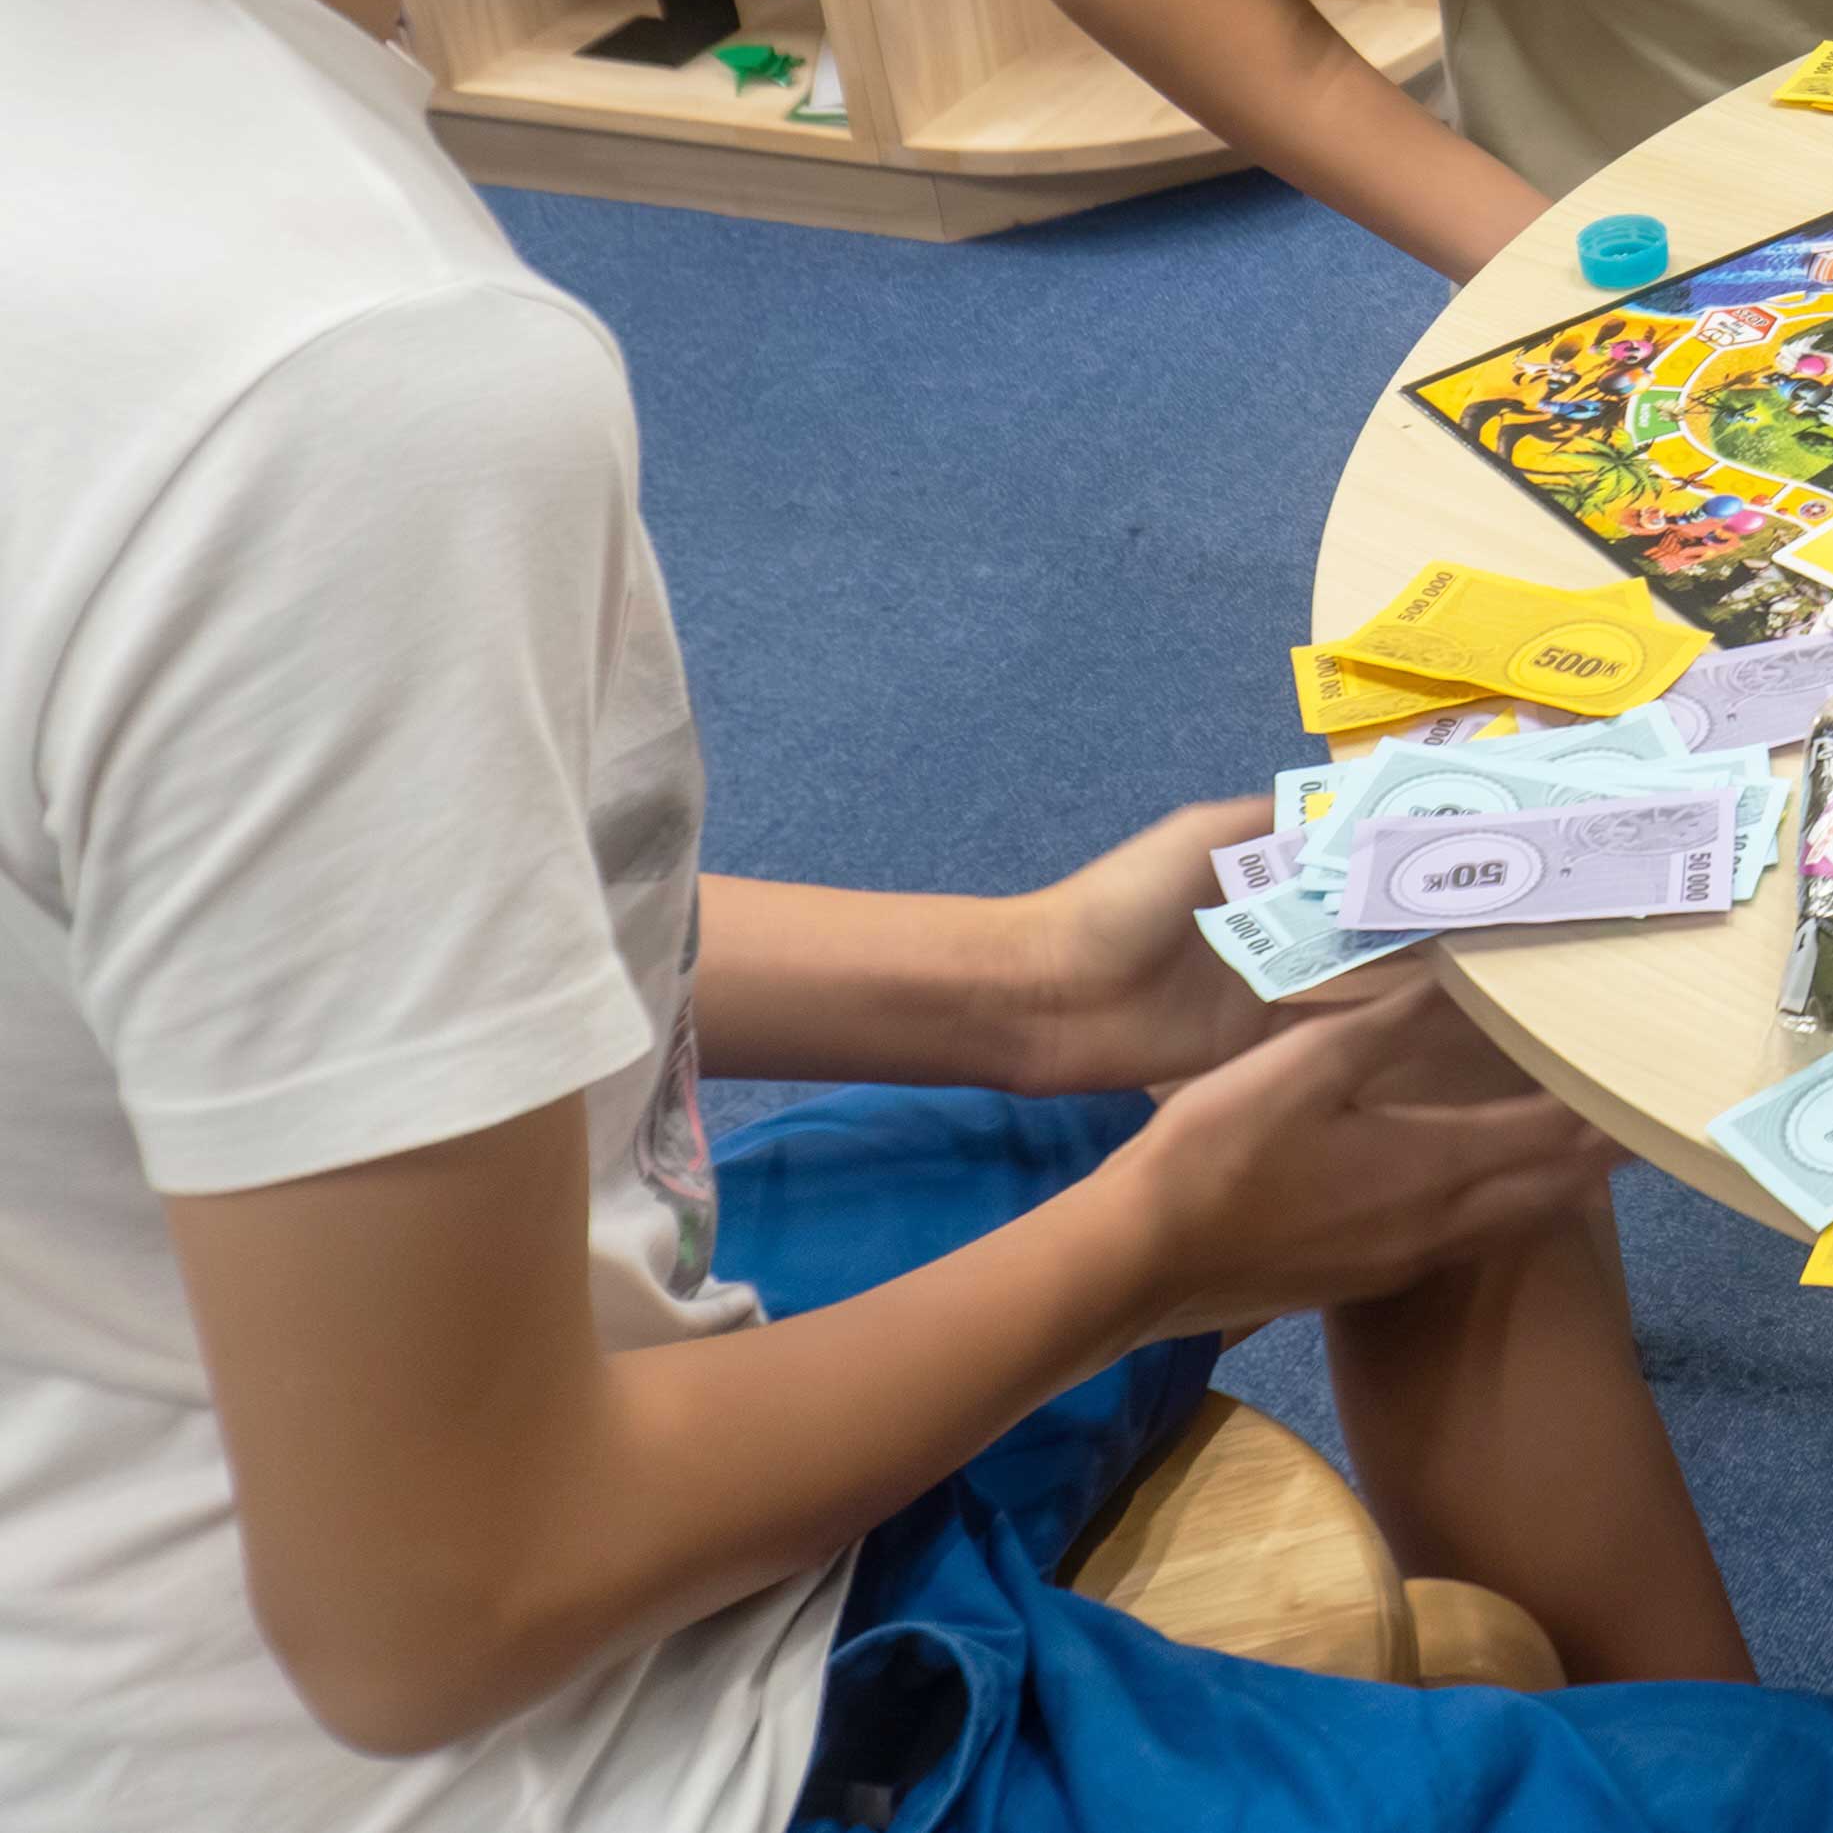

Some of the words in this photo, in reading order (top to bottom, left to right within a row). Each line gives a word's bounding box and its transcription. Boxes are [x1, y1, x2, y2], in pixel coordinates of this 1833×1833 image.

[1735, 308, 1770, 328] STOP
[1399, 593, 1431, 624] 500
[1420, 570, 1455, 600] 000
[1530, 645, 1626, 680] 500K
[1422, 861, 1509, 892] 50K
[1687, 851, 1712, 872] 50
[1685, 873, 1711, 902] 000
